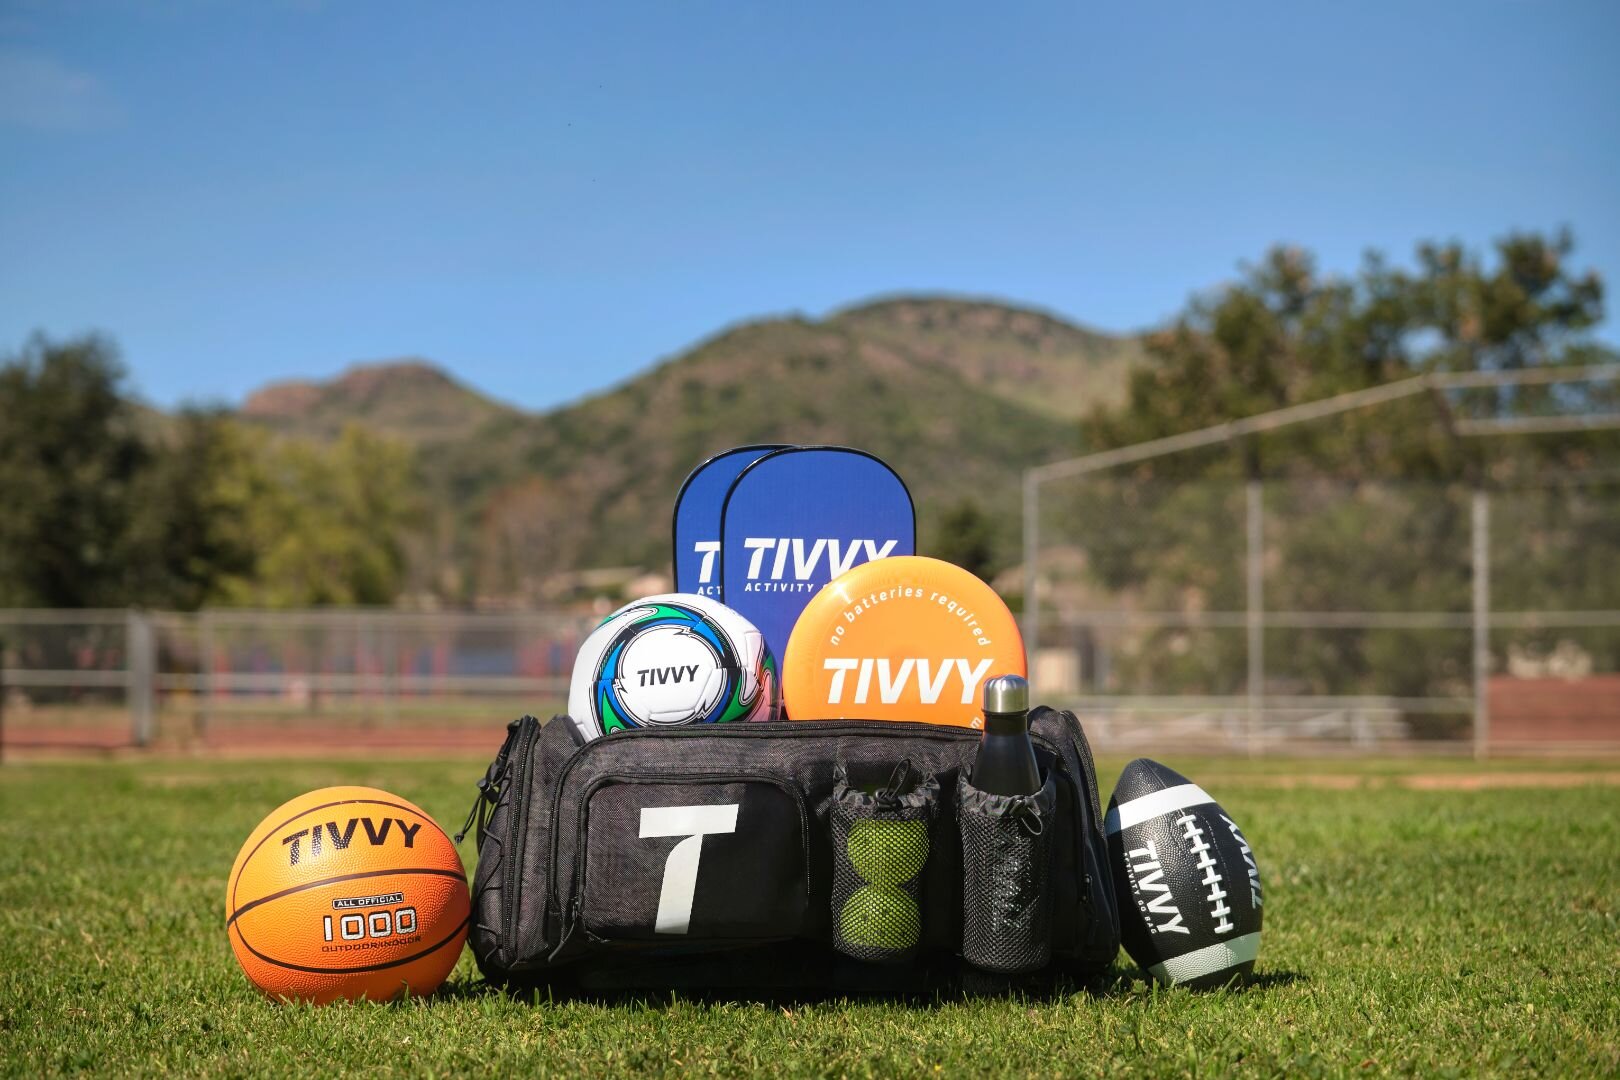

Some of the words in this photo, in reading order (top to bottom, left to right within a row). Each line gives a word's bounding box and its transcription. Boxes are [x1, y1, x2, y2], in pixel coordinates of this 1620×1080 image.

[744, 582, 814, 593] ACTIVITY
[830, 625, 845, 646] no
[843, 585, 923, 623] batteries
[930, 591, 992, 646] required
[637, 664, 699, 688] TIVVY
[823, 658, 995, 704] TIVVY
[282, 817, 422, 866] TIVVY
[358, 895, 401, 906] OFFICIAL
[1128, 839, 1191, 934] TIVVY
[323, 906, 417, 942] 1000
